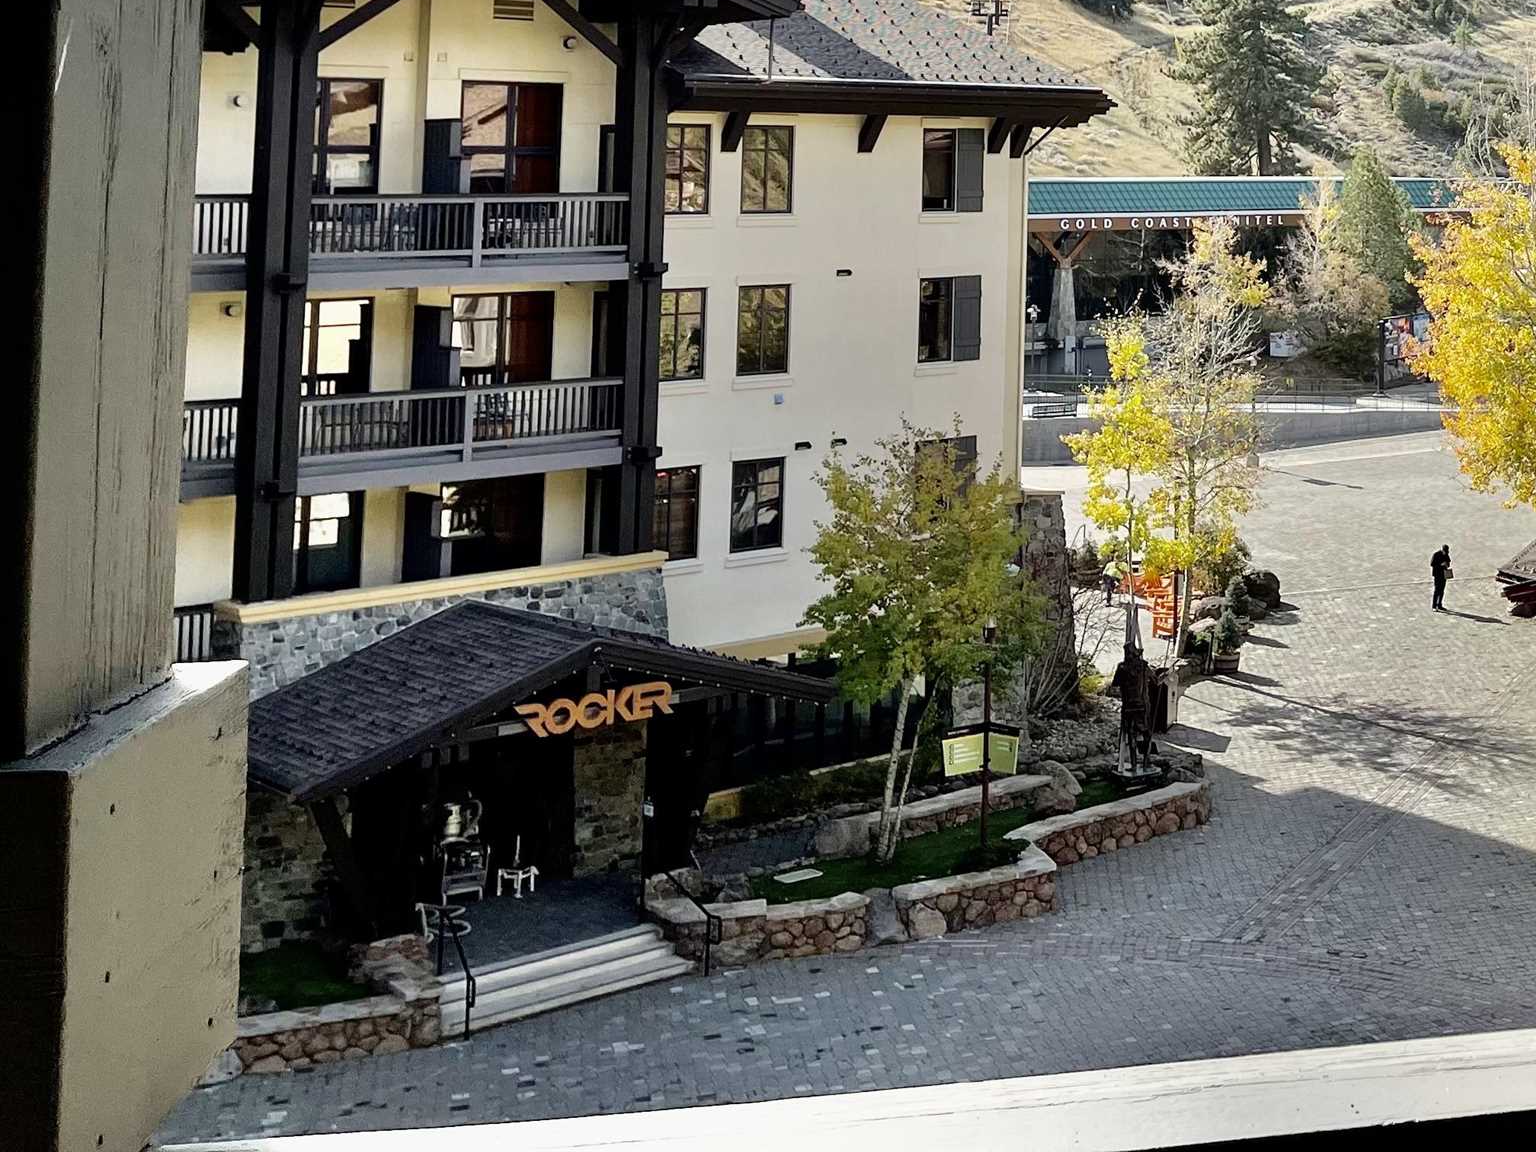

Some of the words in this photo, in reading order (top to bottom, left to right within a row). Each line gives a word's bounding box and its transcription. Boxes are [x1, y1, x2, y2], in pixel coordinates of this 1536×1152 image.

[1060, 218, 1113, 230] GOLD
[1131, 217, 1192, 229] COAST
[513, 681, 674, 737] ROCKER
